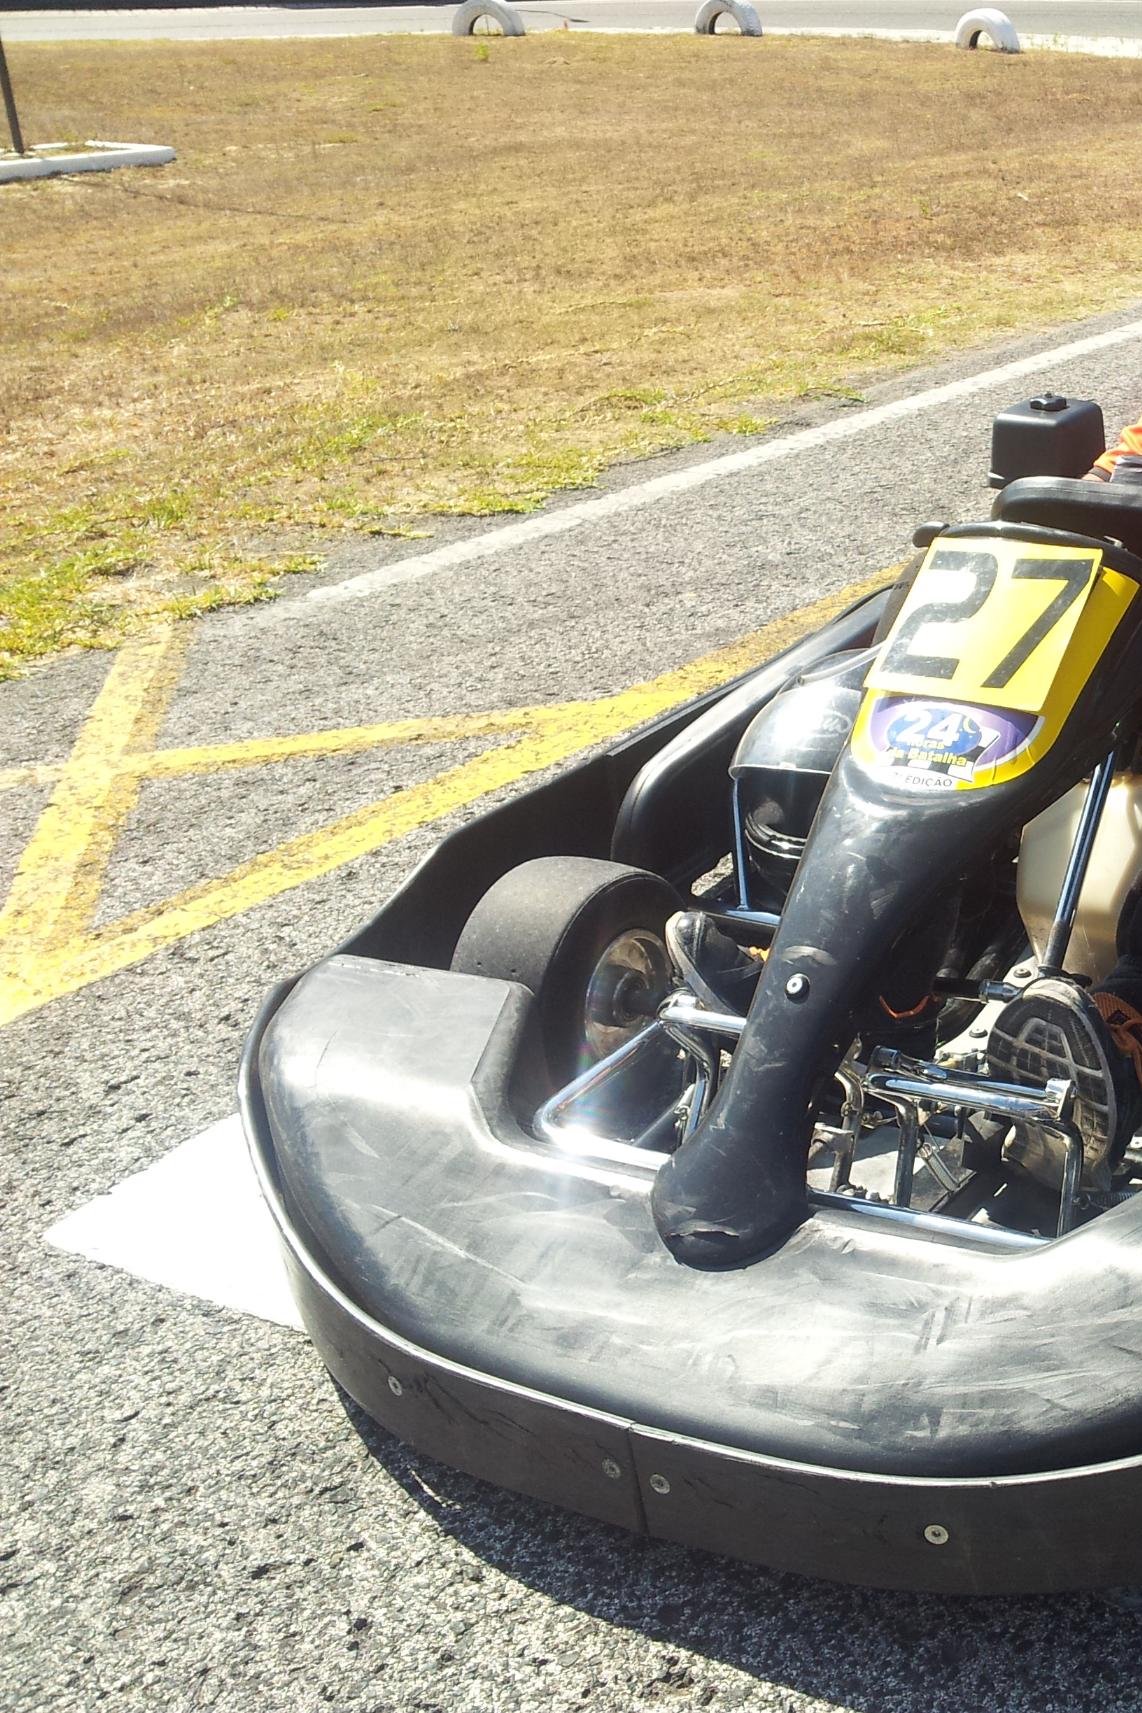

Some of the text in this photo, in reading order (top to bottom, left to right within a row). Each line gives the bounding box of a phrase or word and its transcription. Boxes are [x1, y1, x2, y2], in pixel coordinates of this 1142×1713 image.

[879, 549, 1096, 689] 27
[896, 708, 963, 747] 24
[907, 748, 968, 768] Batalha
[904, 775, 953, 788] EDIÇÃO
